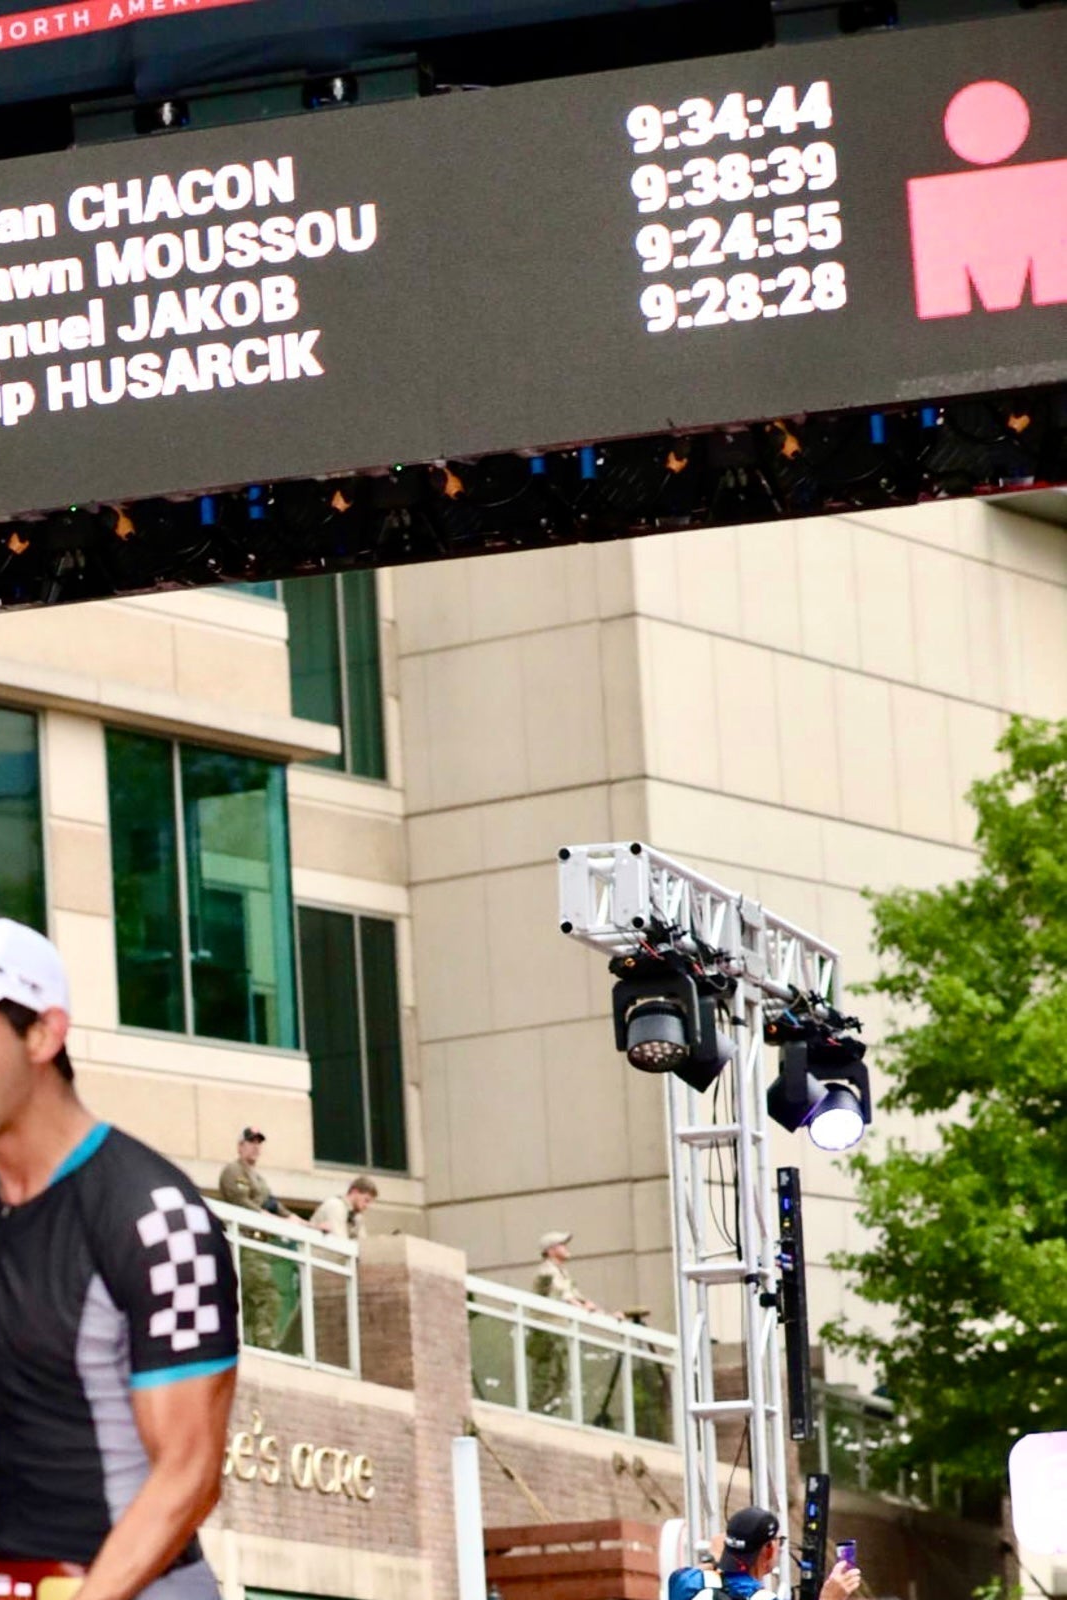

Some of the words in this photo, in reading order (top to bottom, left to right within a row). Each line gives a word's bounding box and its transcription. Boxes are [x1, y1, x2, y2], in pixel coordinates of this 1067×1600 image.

[68, 156, 295, 232] CHACON
[626, 81, 833, 154] 9:34:44
[96, 204, 378, 288] MOUSSOU
[631, 141, 837, 212] 9:38:39
[47, 330, 324, 412] HUSARCIK
[640, 261, 847, 332] 9:28:28
[118, 275, 299, 341] JAKOB
[635, 200, 842, 272] 9:24:55
